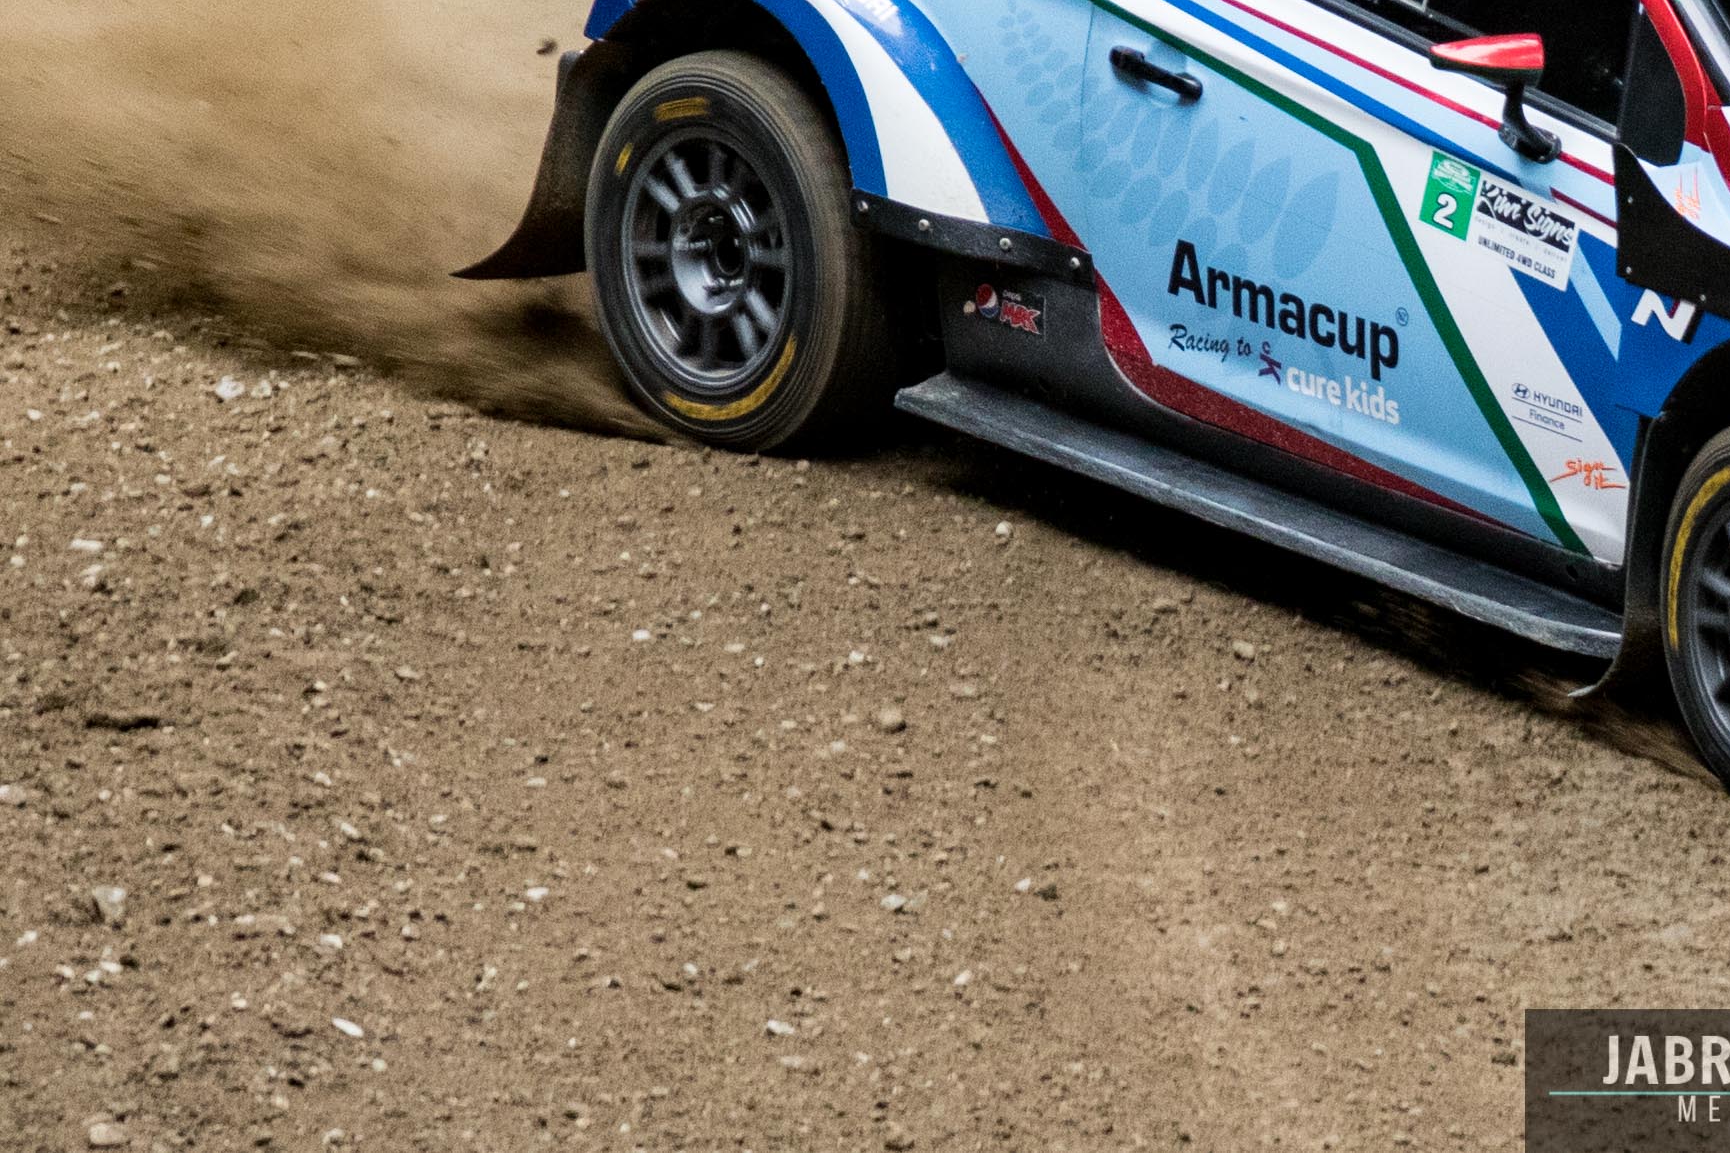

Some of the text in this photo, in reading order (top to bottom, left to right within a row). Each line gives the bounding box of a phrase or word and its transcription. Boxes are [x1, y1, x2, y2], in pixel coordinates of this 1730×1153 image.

[1432, 191, 1458, 230] 2
[1523, 201, 1575, 245] Signs
[1478, 235, 1556, 279] UNLIMITED 4WD CLASS
[1169, 323, 1401, 425] Racing to cure kids
[1529, 408, 1566, 430] Finance
[1533, 390, 1583, 417] HYUNDAI
